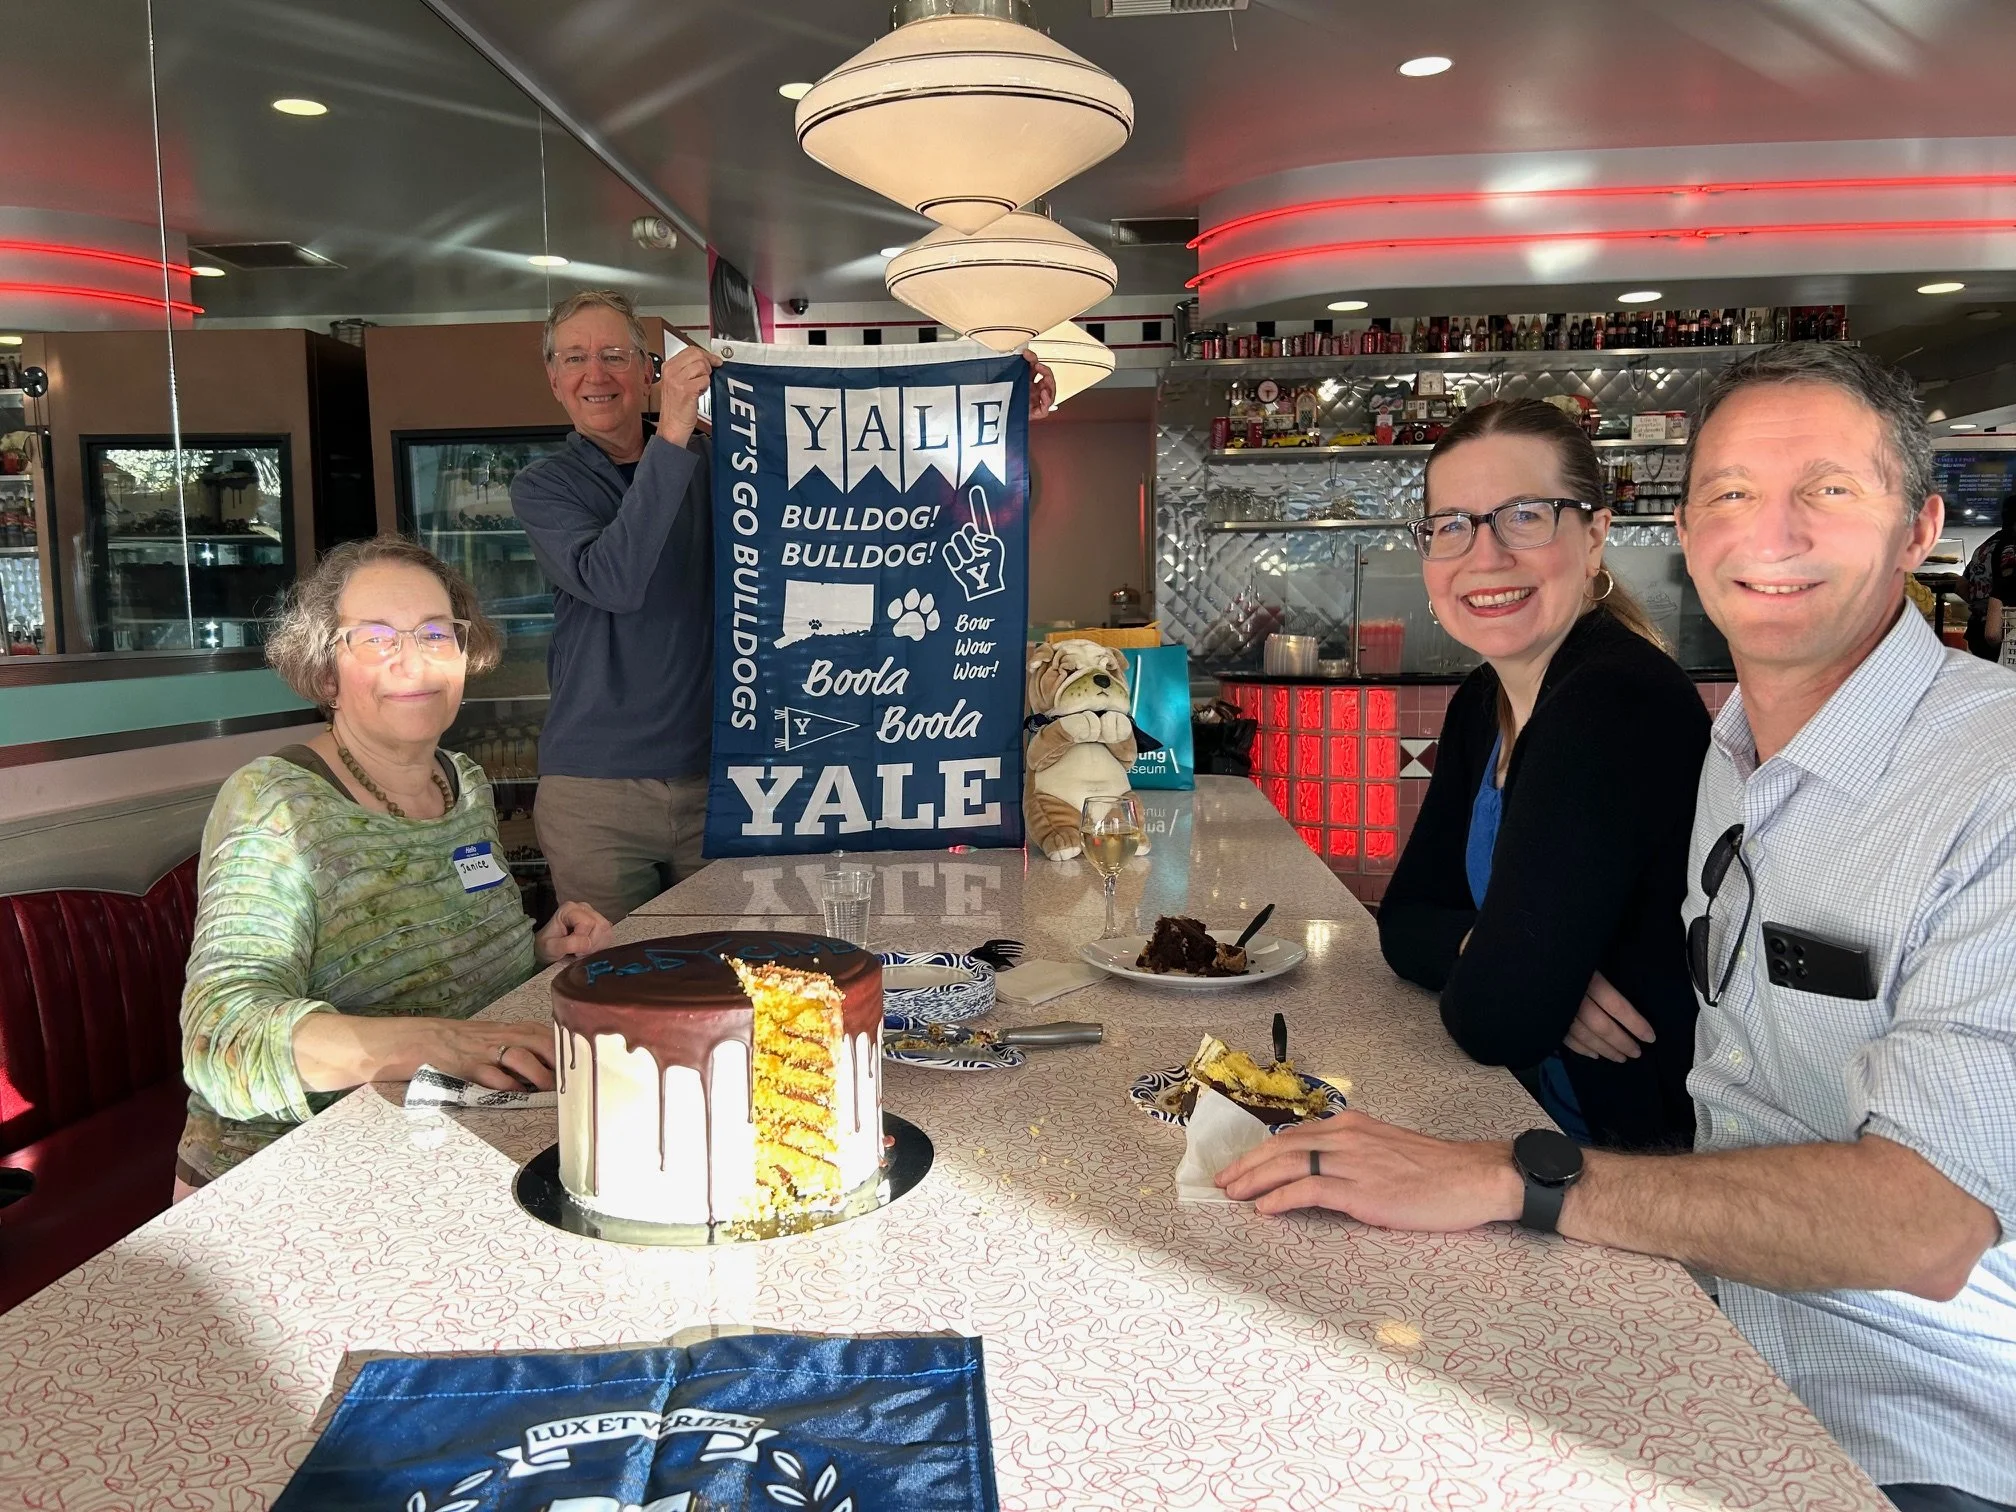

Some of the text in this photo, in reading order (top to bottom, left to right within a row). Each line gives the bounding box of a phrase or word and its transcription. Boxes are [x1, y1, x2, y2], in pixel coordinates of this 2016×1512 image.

[790, 400, 1003, 452] YALE
[781, 504, 941, 532] BULLDOG!
[727, 377, 760, 731] LET'S GO BULLDOGS
[781, 541, 937, 568] BULLDOG!
[966, 561, 992, 591] Y
[954, 613, 995, 632] Bow
[954, 637, 996, 656] Wow
[802, 656, 910, 697] Boola
[952, 661, 1000, 681] Wow!
[793, 717, 812, 735] Y
[876, 698, 983, 744] Boola
[727, 757, 1002, 836] YALE
[532, 1420, 593, 1442] LUX
[597, 1416, 637, 1433] ET
